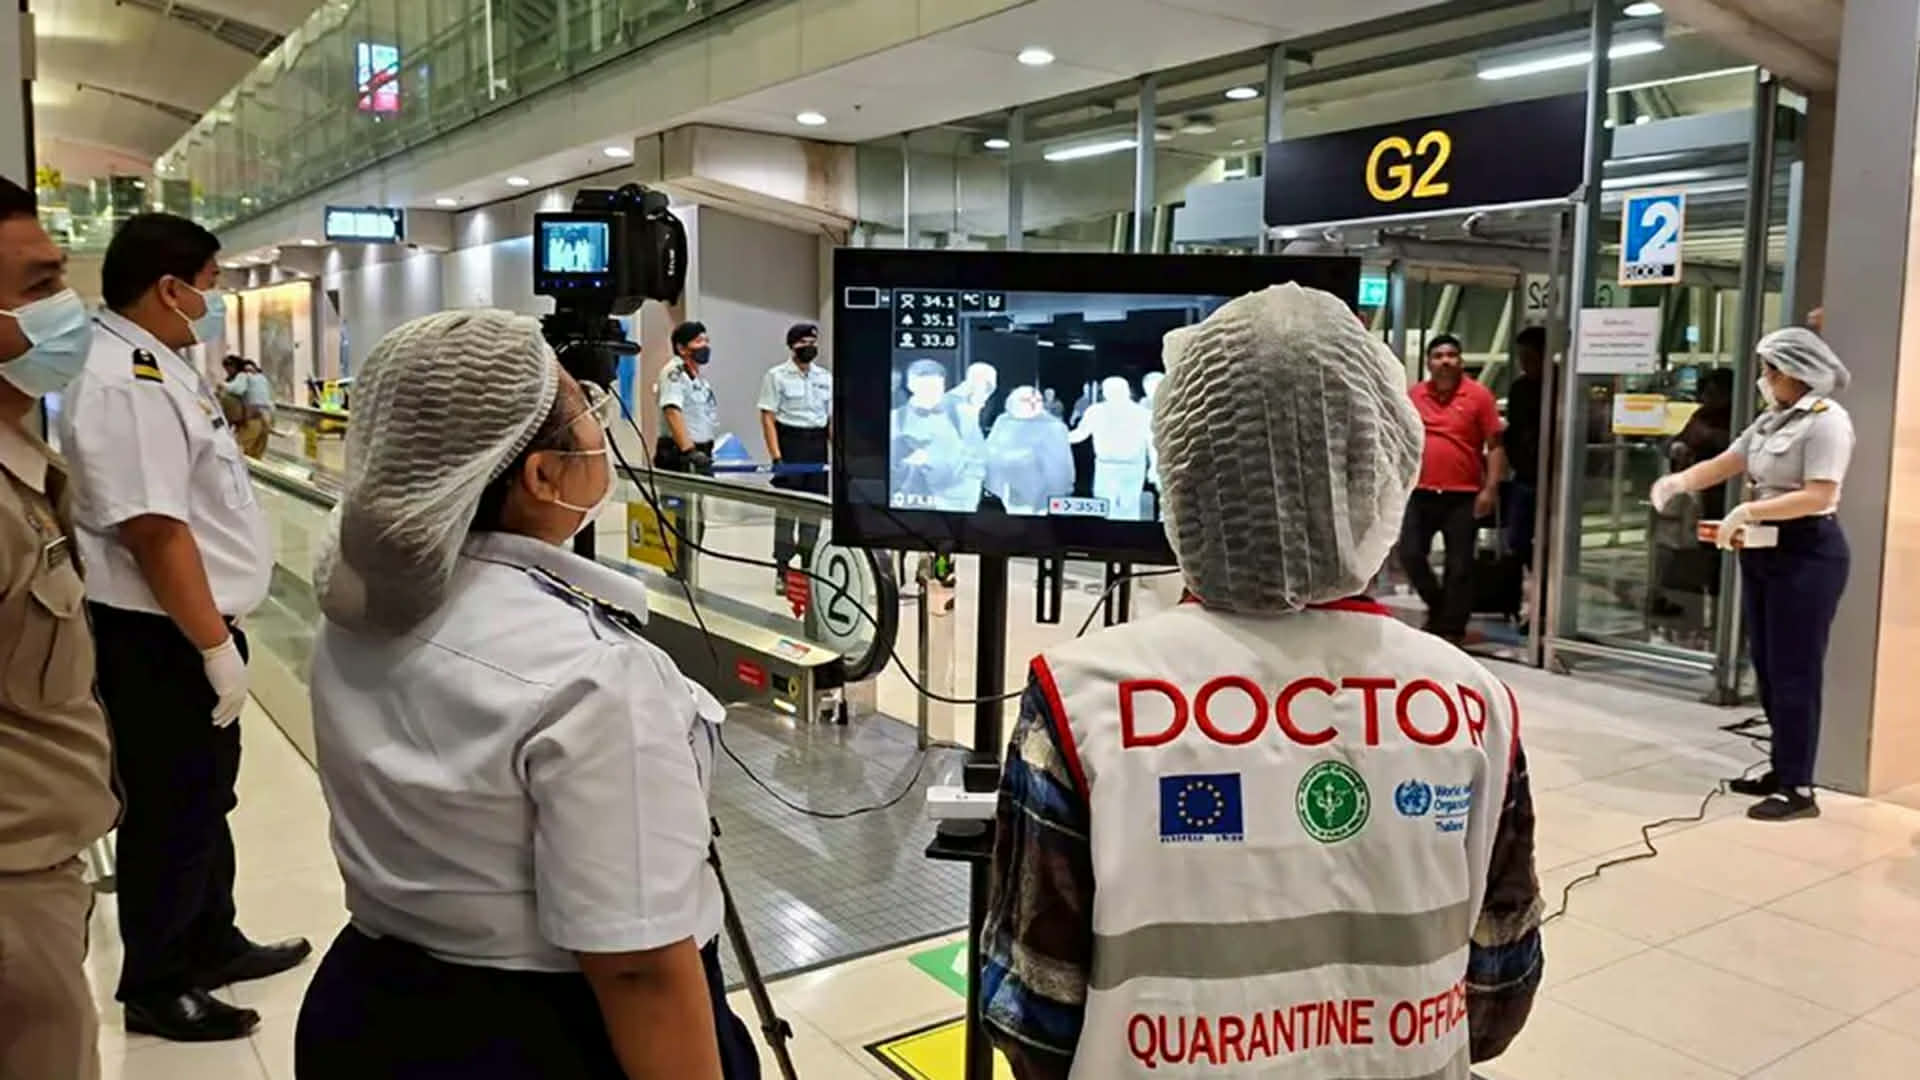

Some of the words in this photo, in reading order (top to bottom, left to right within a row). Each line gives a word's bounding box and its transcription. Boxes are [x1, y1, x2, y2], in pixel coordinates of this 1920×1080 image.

[1366, 130, 1451, 202] G2
[1639, 201, 1679, 263] 2
[922, 294, 956, 309] 34.1
[922, 313, 956, 327] 35.1
[921, 333, 956, 348] 33.8
[827, 553, 851, 626] 2
[1118, 675, 1487, 749] DOCTOR
[1128, 999, 1375, 1069] QUARANTINE
